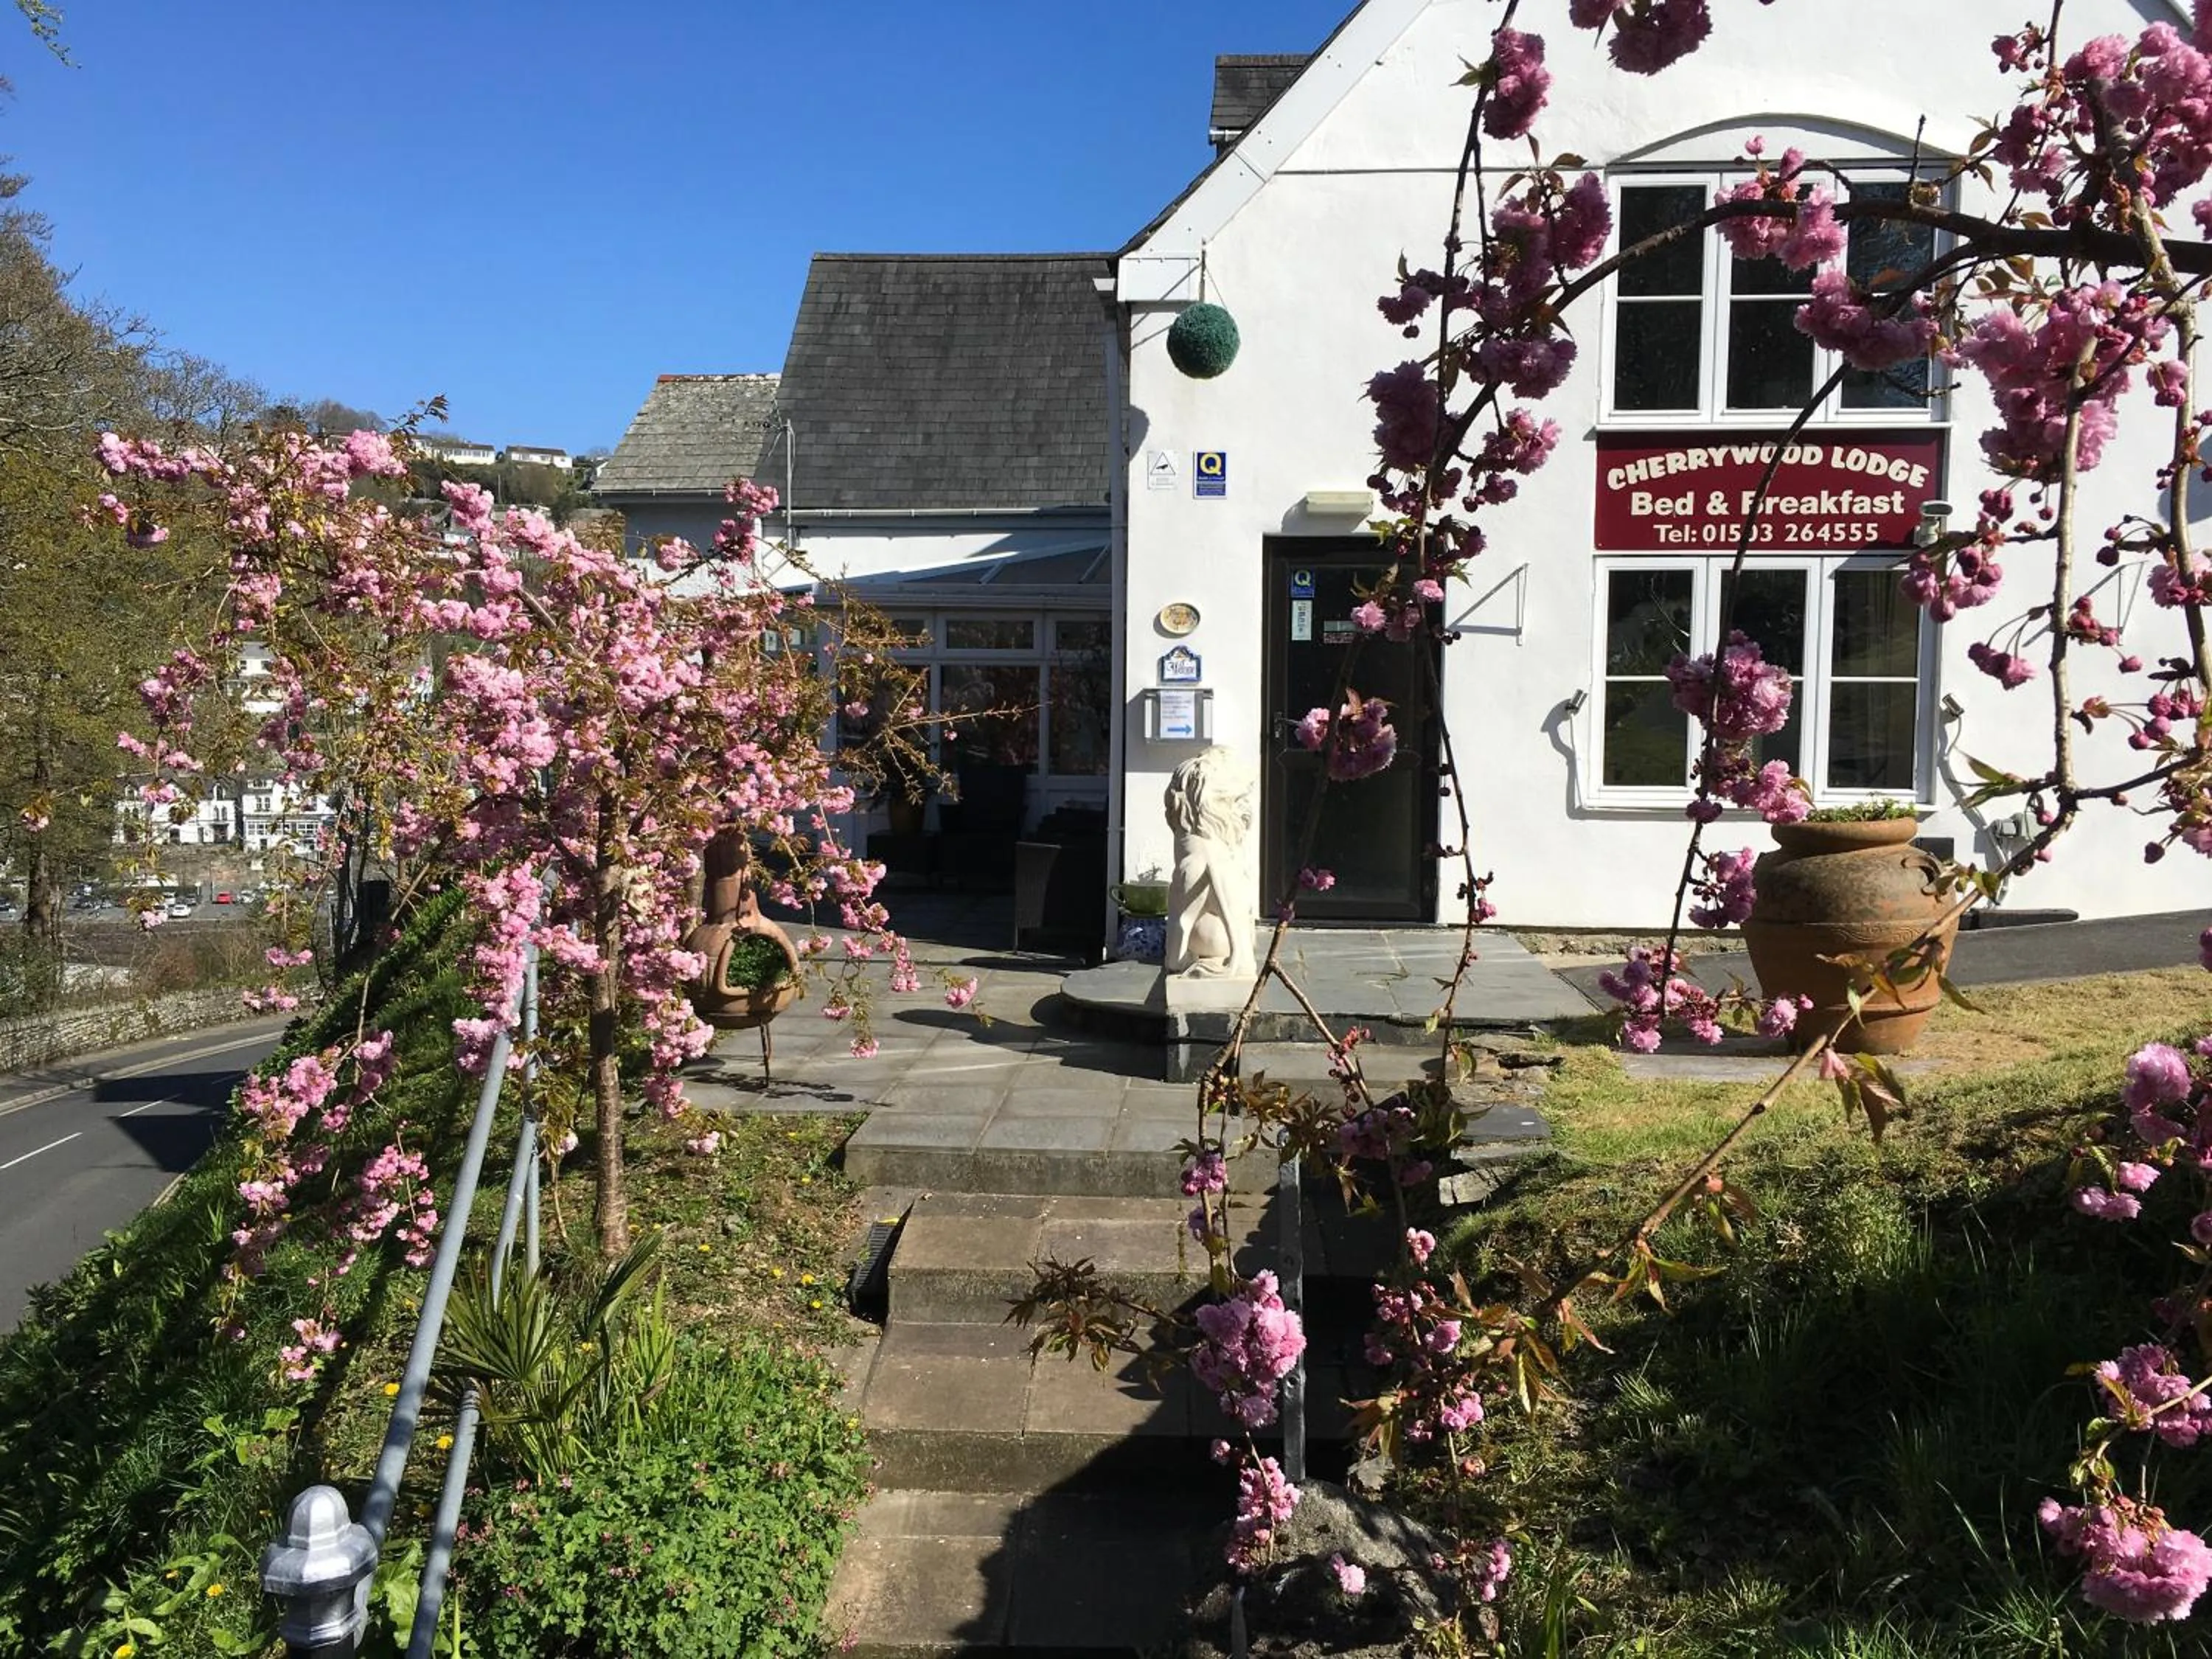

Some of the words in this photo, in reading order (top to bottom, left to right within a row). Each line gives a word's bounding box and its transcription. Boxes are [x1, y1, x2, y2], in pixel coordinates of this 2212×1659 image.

[1200, 453, 1221, 475] Q
[1607, 442, 1823, 490] CHERRYWOOD
[1831, 446, 1929, 487] LODGE
[1631, 491, 1694, 515] Bed
[1706, 490, 1730, 515] &
[1741, 490, 1905, 515] Breakfast
[1653, 524, 1696, 543] Tel:
[1784, 523, 1878, 542] 264555
